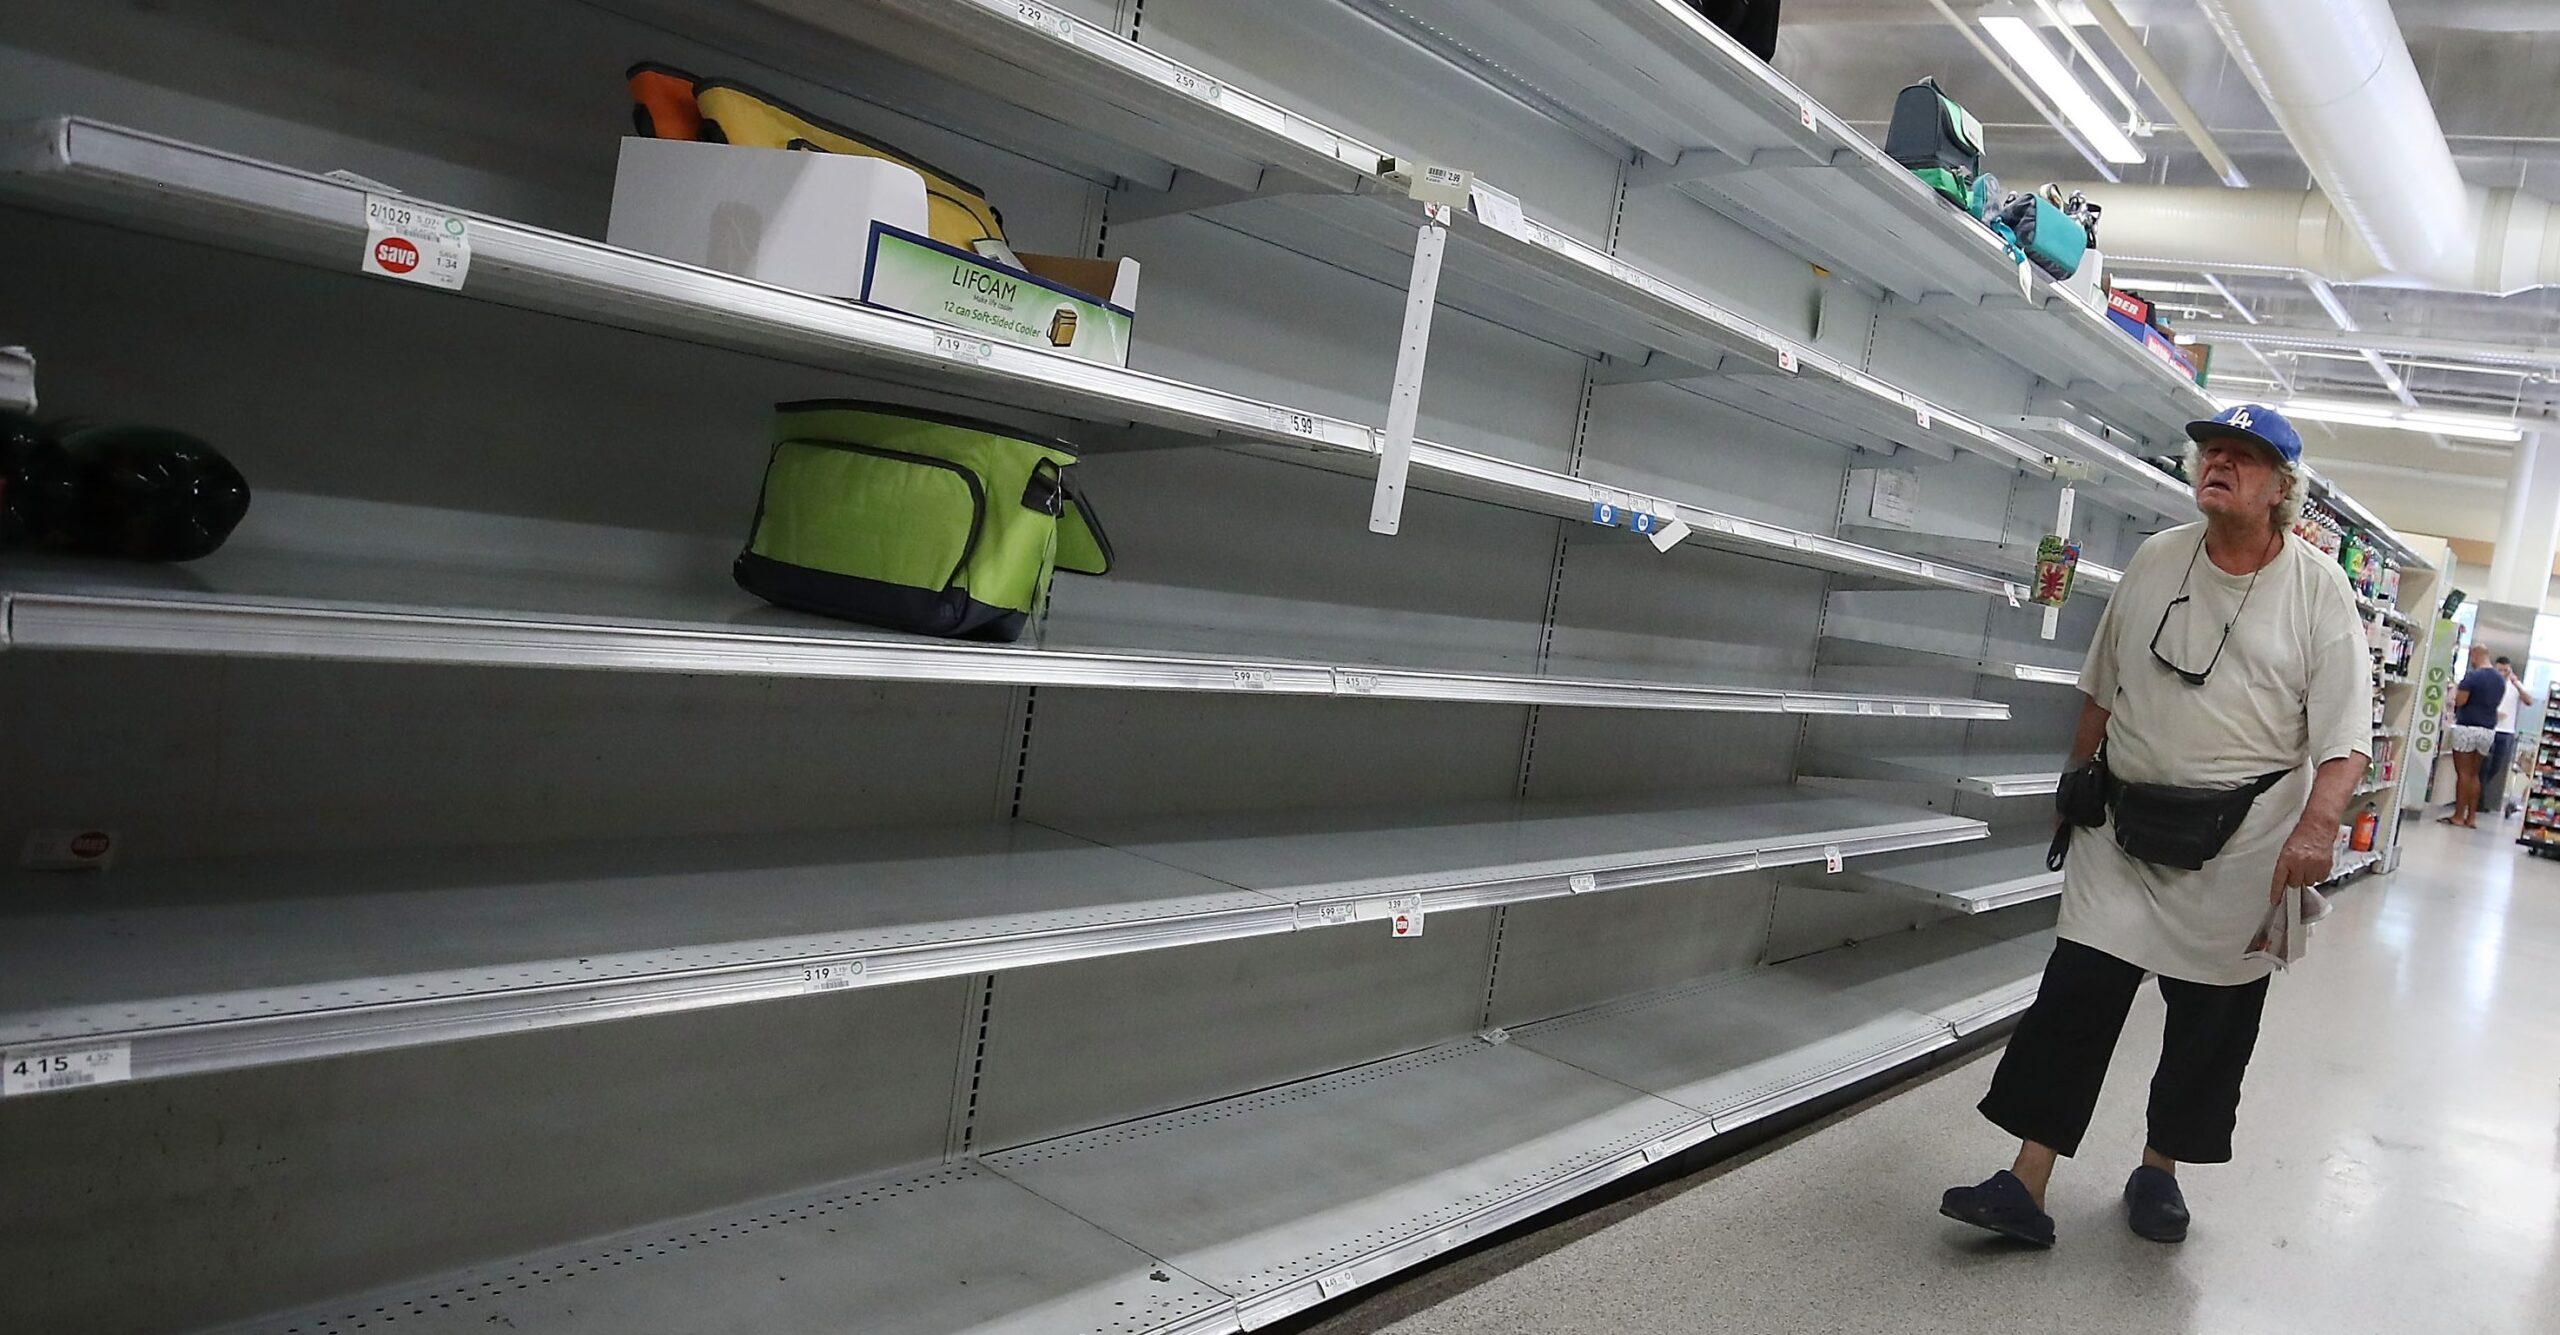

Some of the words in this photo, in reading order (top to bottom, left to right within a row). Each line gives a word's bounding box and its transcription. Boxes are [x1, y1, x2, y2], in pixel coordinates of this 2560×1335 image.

[378, 244, 417, 267] save
[952, 265, 1017, 303] LIFOAM
[944, 301, 956, 313] 12
[955, 305, 971, 318] can
[971, 308, 1015, 333] Soft-Sided
[1015, 322, 1041, 338] Cooler
[2226, 406, 2254, 430] LA
[2419, 669, 2443, 751] VALUE
